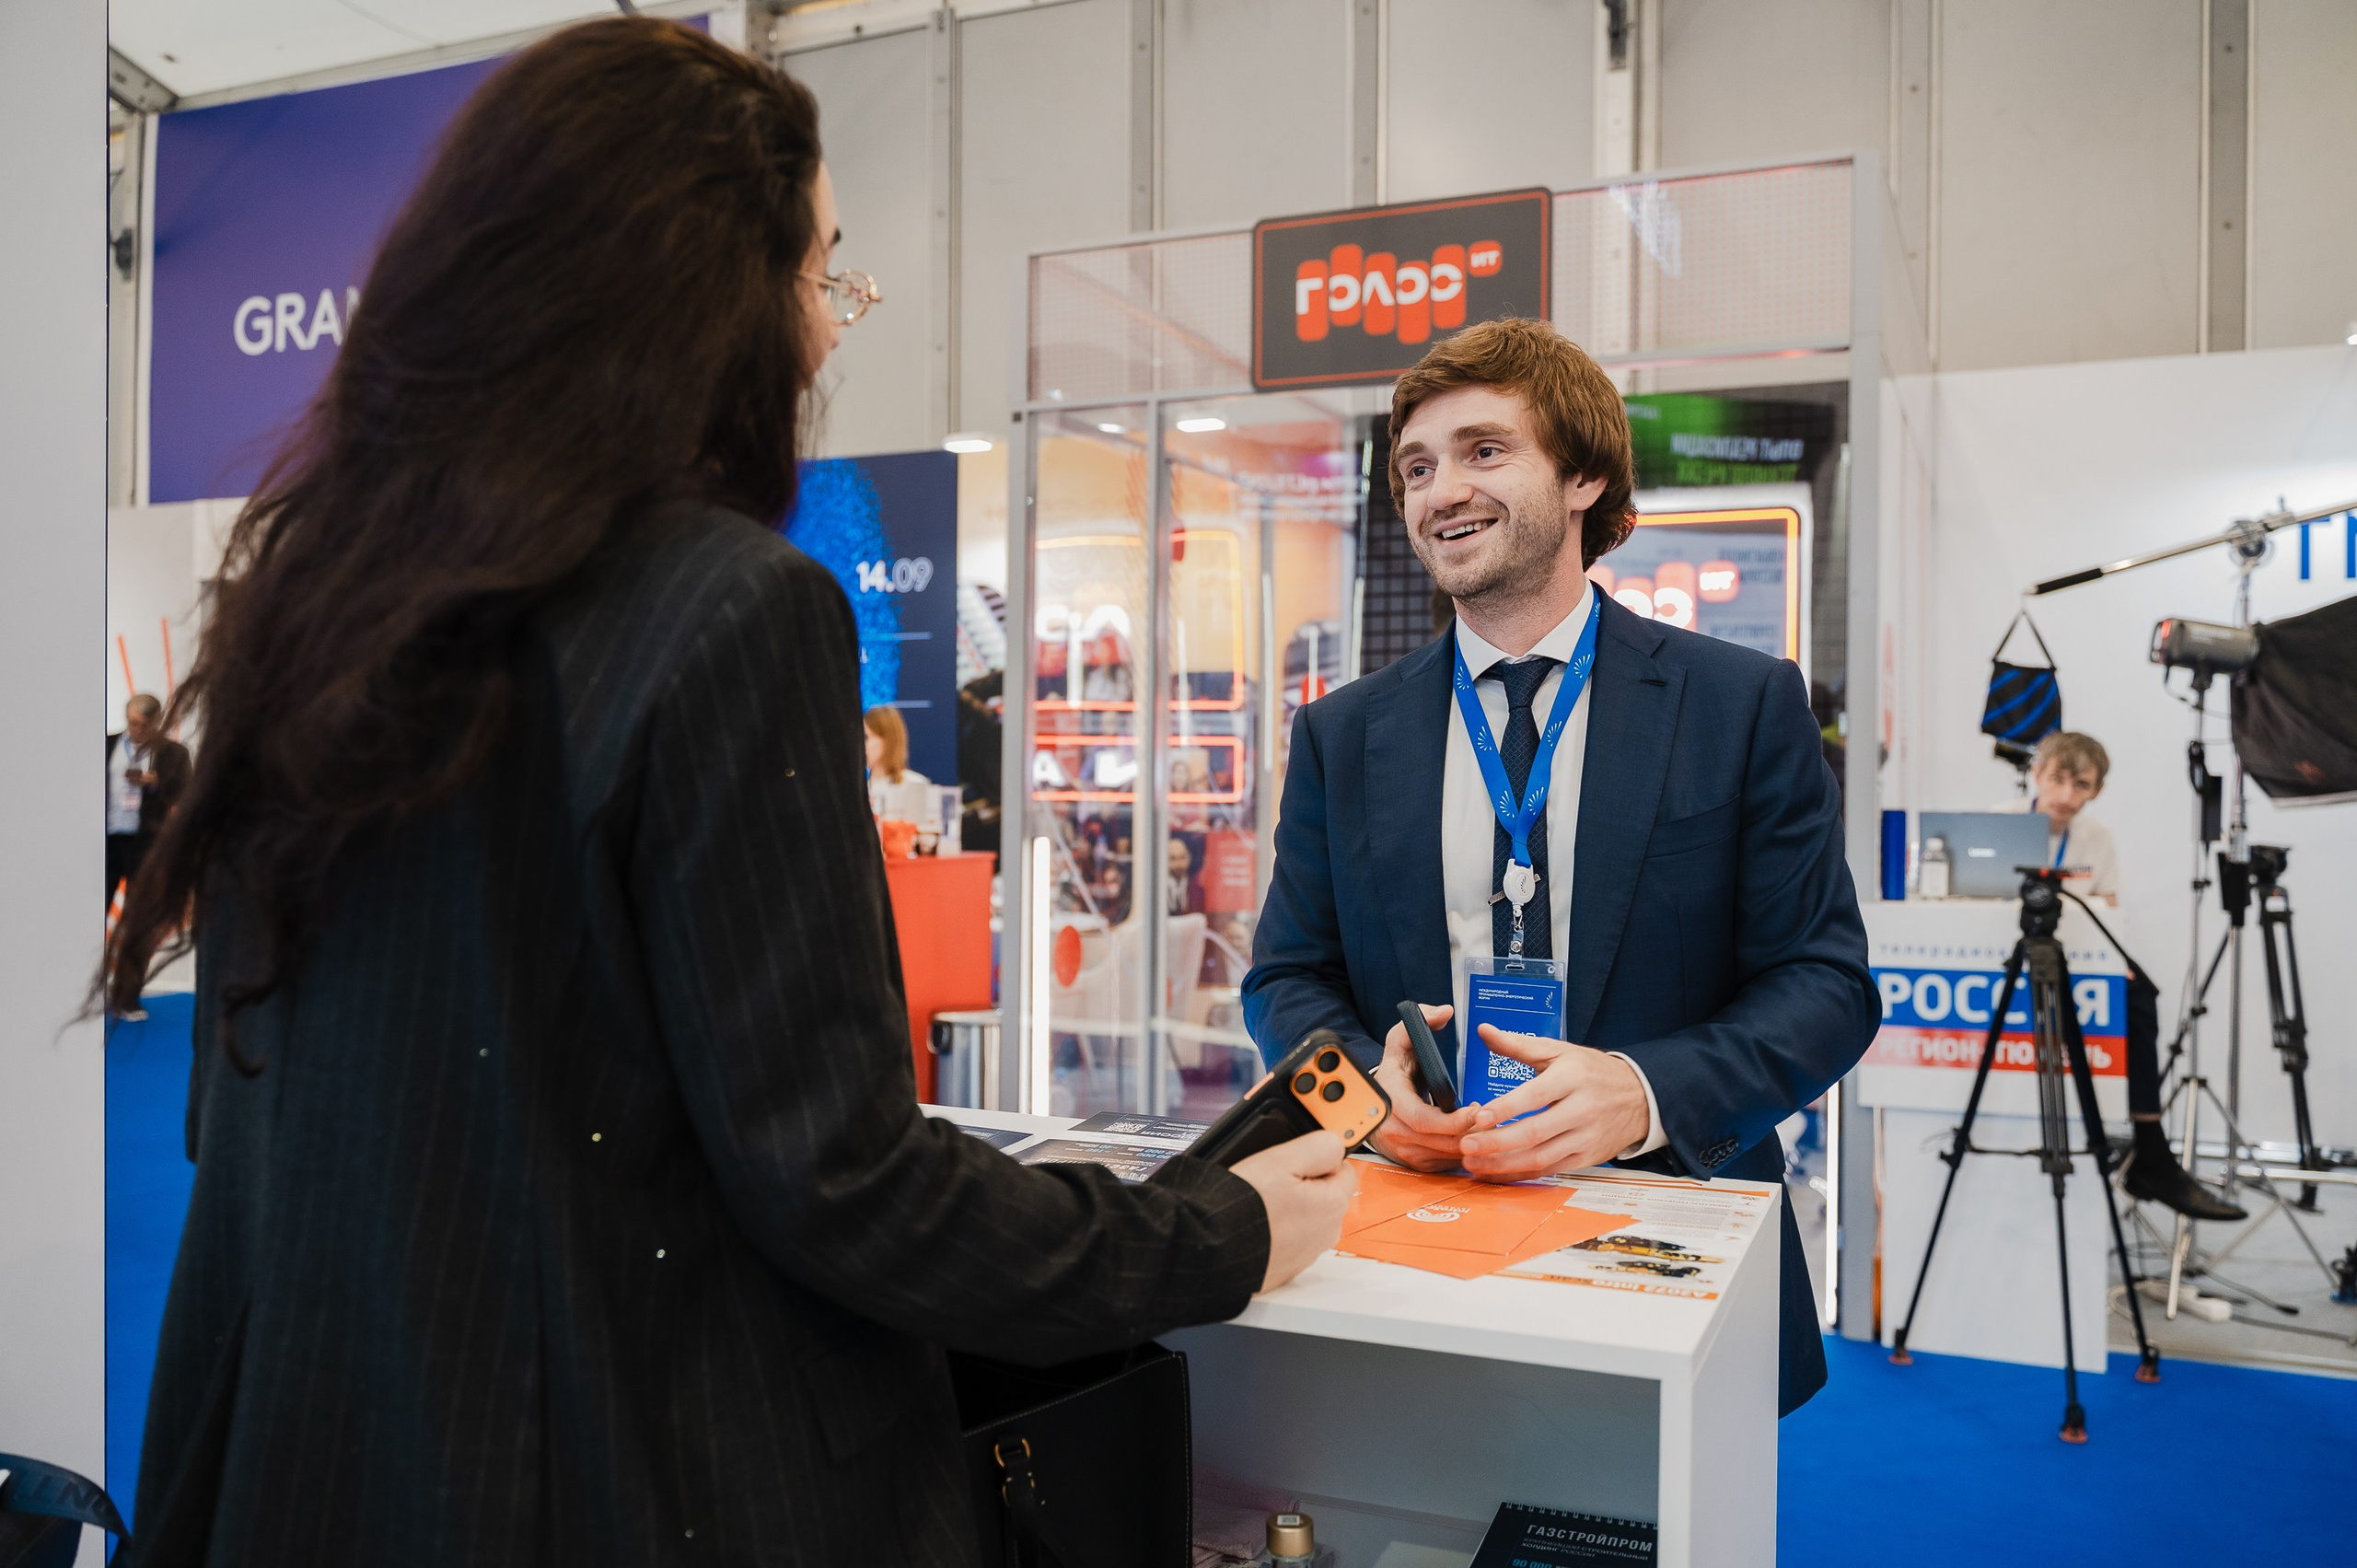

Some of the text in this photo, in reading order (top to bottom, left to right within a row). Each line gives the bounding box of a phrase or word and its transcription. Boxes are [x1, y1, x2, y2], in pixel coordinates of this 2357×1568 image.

[1295, 250, 1500, 315] ГОЛОС ИТ
[856, 556, 934, 593] 14.09
[1877, 972, 2109, 1027] РОССЯ
[1521, 1542, 1596, 1558] ХОЛДИНГ РОССИИ
[1527, 1524, 1653, 1552] ГАЗСТРОЙПРОМ
[1512, 1558, 1528, 1568] 90
[1581, 1547, 1648, 1561] СТРОИТЕЛЬНЫЙ
